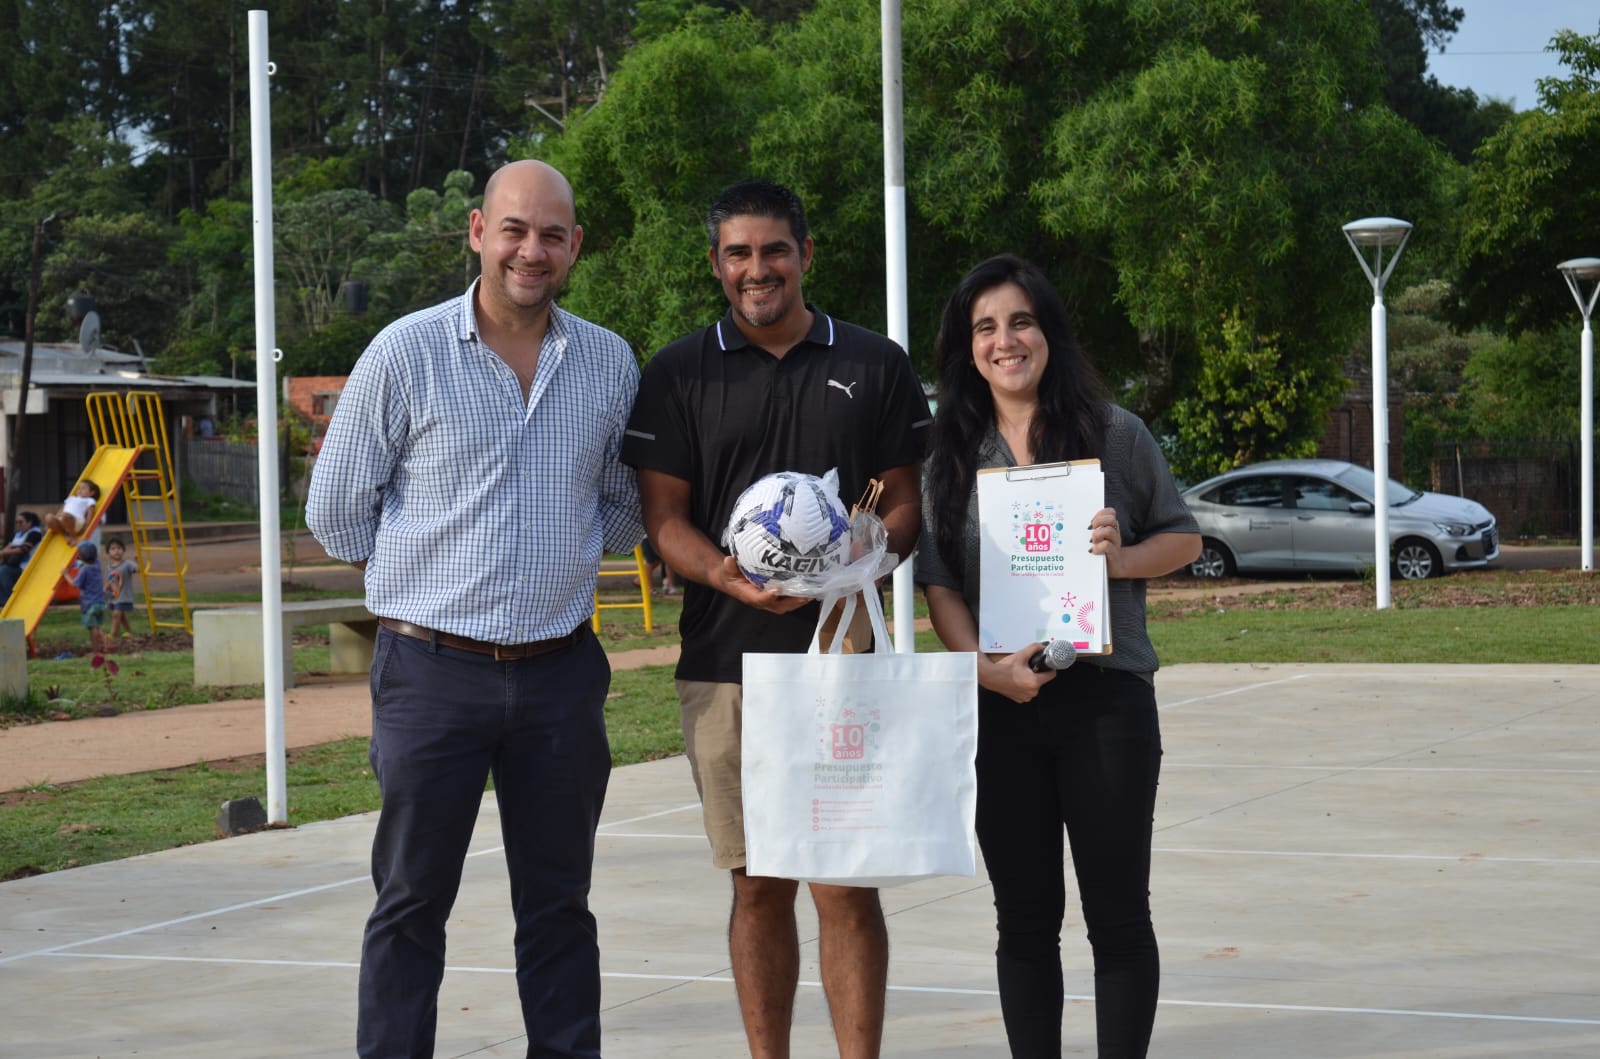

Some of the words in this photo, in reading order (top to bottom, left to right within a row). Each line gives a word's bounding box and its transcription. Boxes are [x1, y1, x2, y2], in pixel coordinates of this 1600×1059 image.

[1027, 526, 1049, 542] 10
[1028, 542, 1049, 551] años
[1011, 554, 1064, 564] Presupuesto
[1011, 563, 1064, 572] Participativo
[835, 727, 862, 747] 10
[835, 747, 861, 757] años
[814, 763, 882, 774] Presupuesto
[814, 773, 882, 785] Participativo
